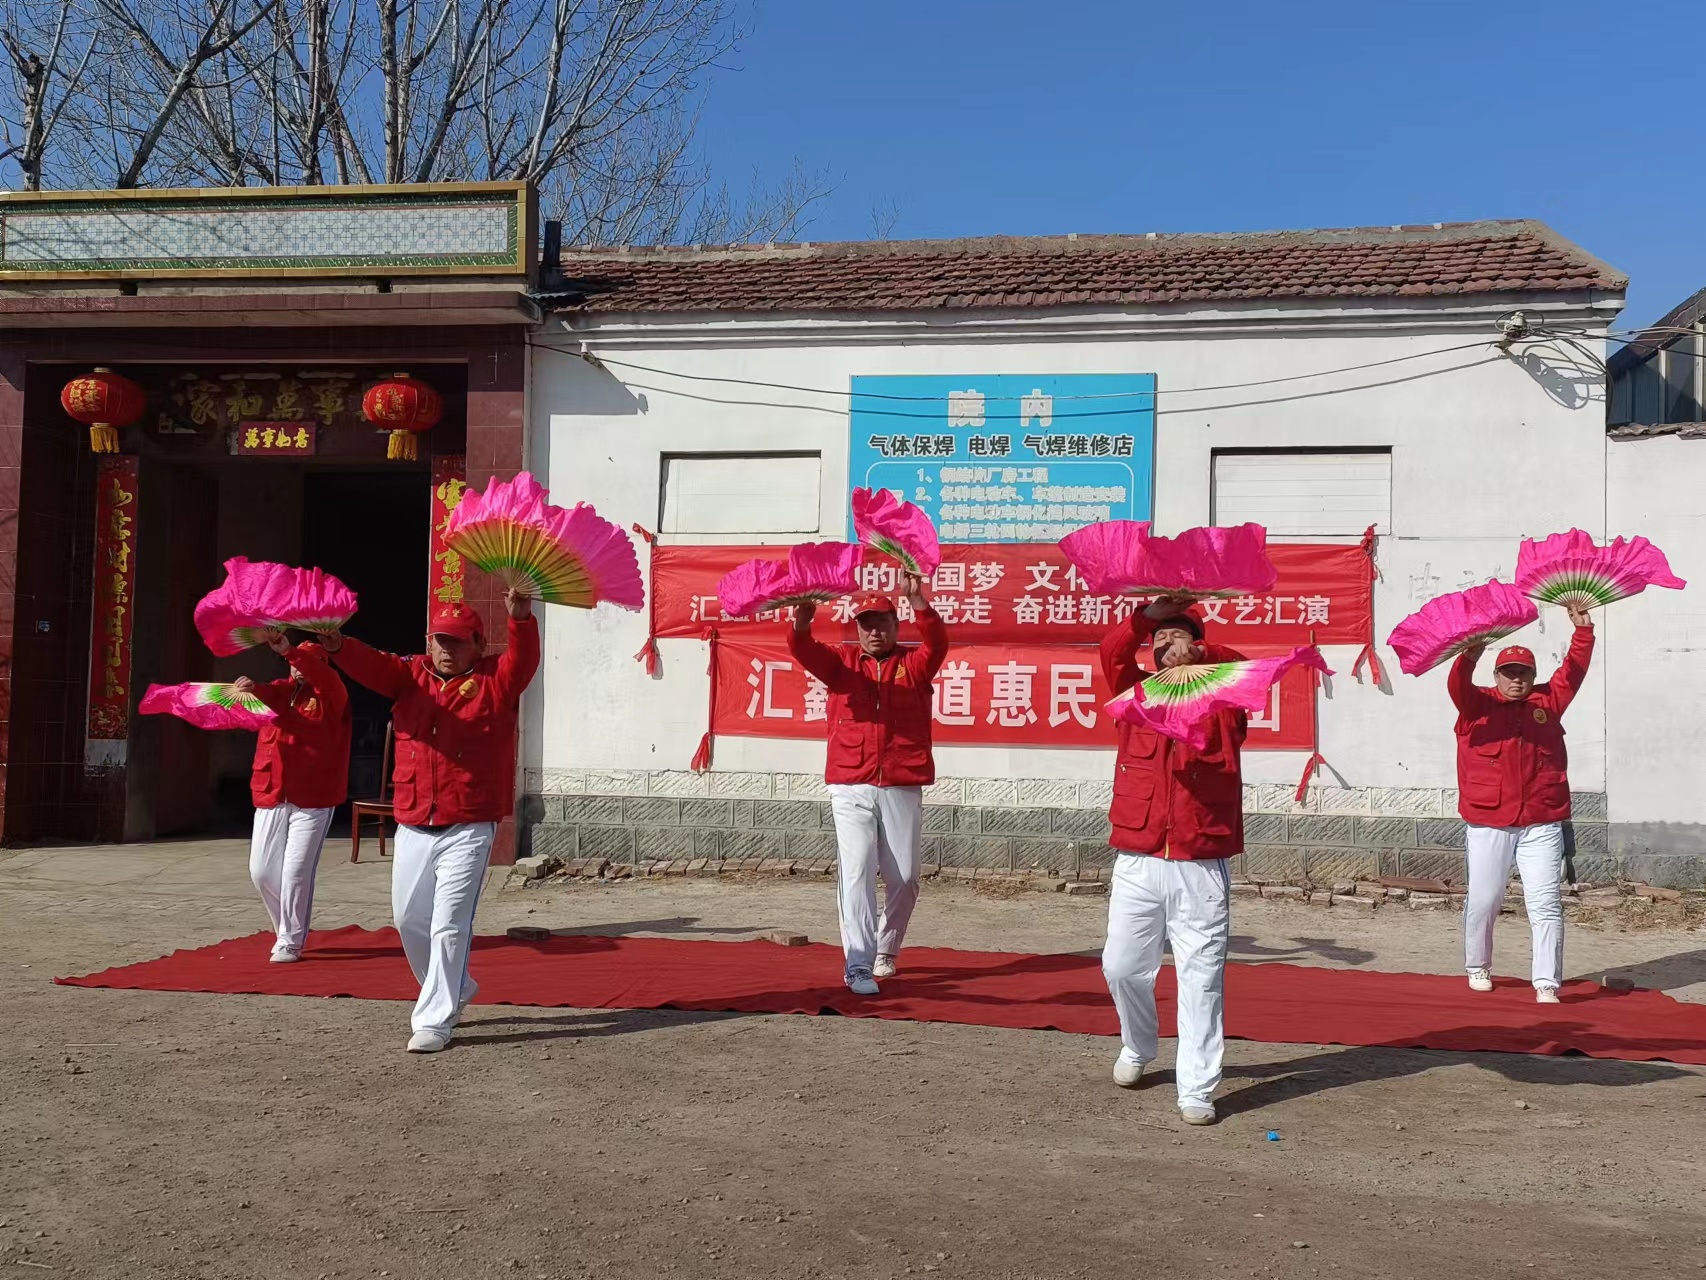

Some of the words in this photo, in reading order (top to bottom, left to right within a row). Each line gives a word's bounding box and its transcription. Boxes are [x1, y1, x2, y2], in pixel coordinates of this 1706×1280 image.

[868, 435, 954, 456] 气体保焊
[968, 435, 1011, 456] 电焊
[1023, 434, 1133, 456] 气焊维修店
[854, 561, 1005, 592] 的国梦
[1012, 594, 1157, 625] 奋进新征
[1197, 595, 1331, 626] 文艺汇演
